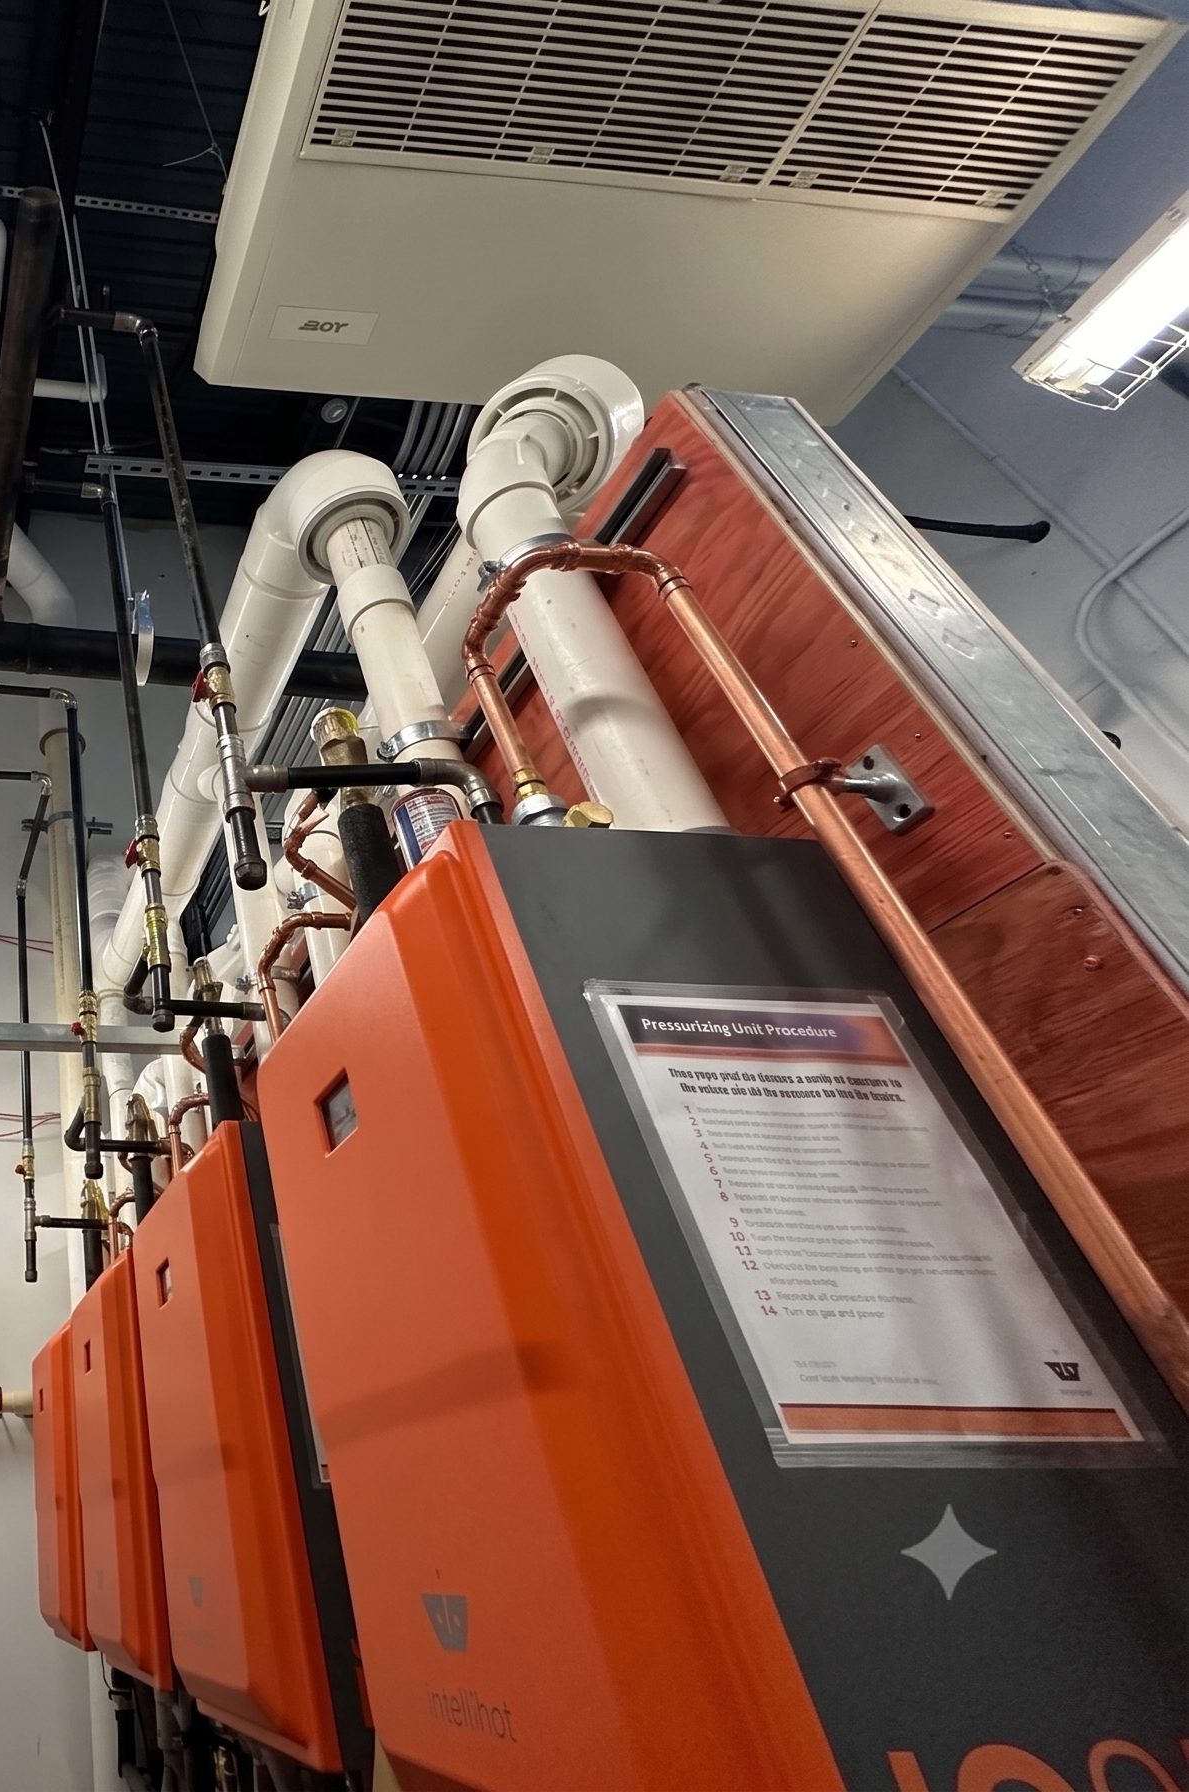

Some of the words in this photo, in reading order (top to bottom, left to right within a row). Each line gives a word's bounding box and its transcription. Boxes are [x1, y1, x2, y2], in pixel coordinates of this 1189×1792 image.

[641, 1018, 731, 1037] Pressurizing
[732, 1022, 764, 1036] Unit
[765, 1024, 837, 1038] Procedure
[689, 1117, 699, 1126] 2
[694, 1129, 703, 1138] 3
[700, 1141, 709, 1150] 4
[704, 1153, 713, 1163] 5
[709, 1166, 719, 1176] 6
[714, 1179, 722, 1189] 7
[720, 1191, 729, 1202] 8
[729, 1217, 739, 1228] 9
[741, 1260, 760, 1271] 12
[755, 1290, 772, 1301] 13
[760, 1305, 779, 1316] 14
